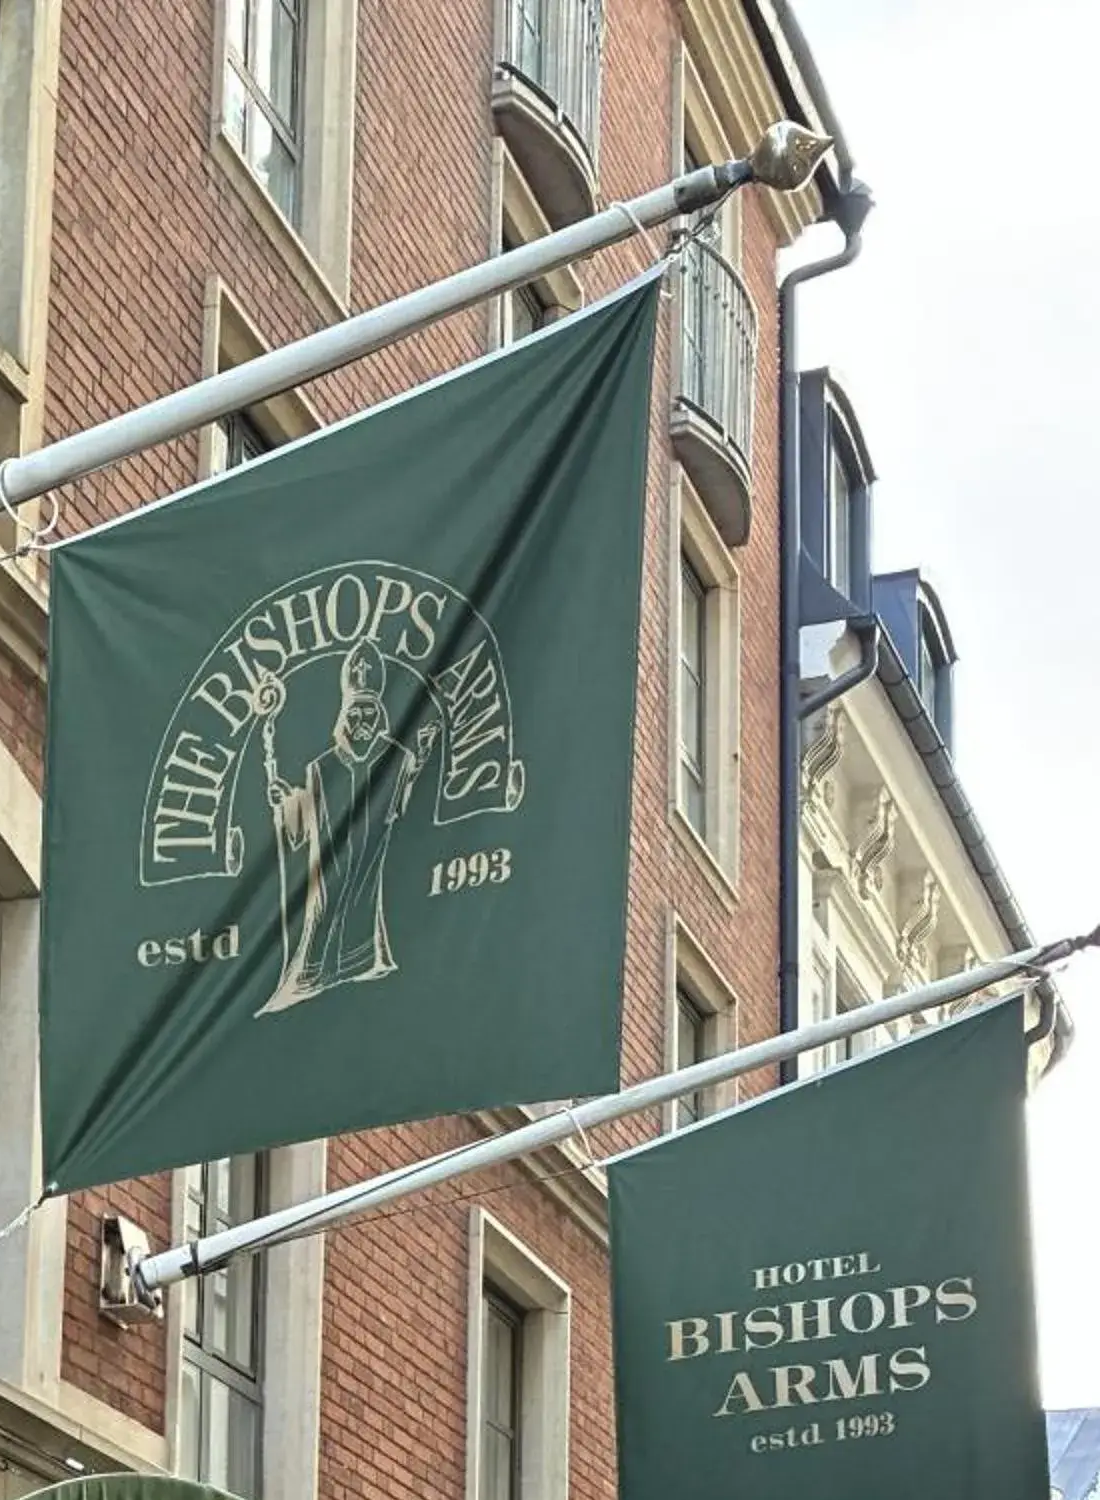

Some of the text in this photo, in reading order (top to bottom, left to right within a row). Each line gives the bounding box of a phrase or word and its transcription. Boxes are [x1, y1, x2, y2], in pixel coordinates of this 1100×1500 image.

[153, 575, 504, 863] THE BISHOPS ARMS
[138, 849, 512, 966] estd 1993
[753, 1253, 881, 1289] HOTEL
[665, 1277, 976, 1361] BISHOPS
[712, 1346, 930, 1417] ARMS
[750, 1412, 895, 1453] estd 1993
